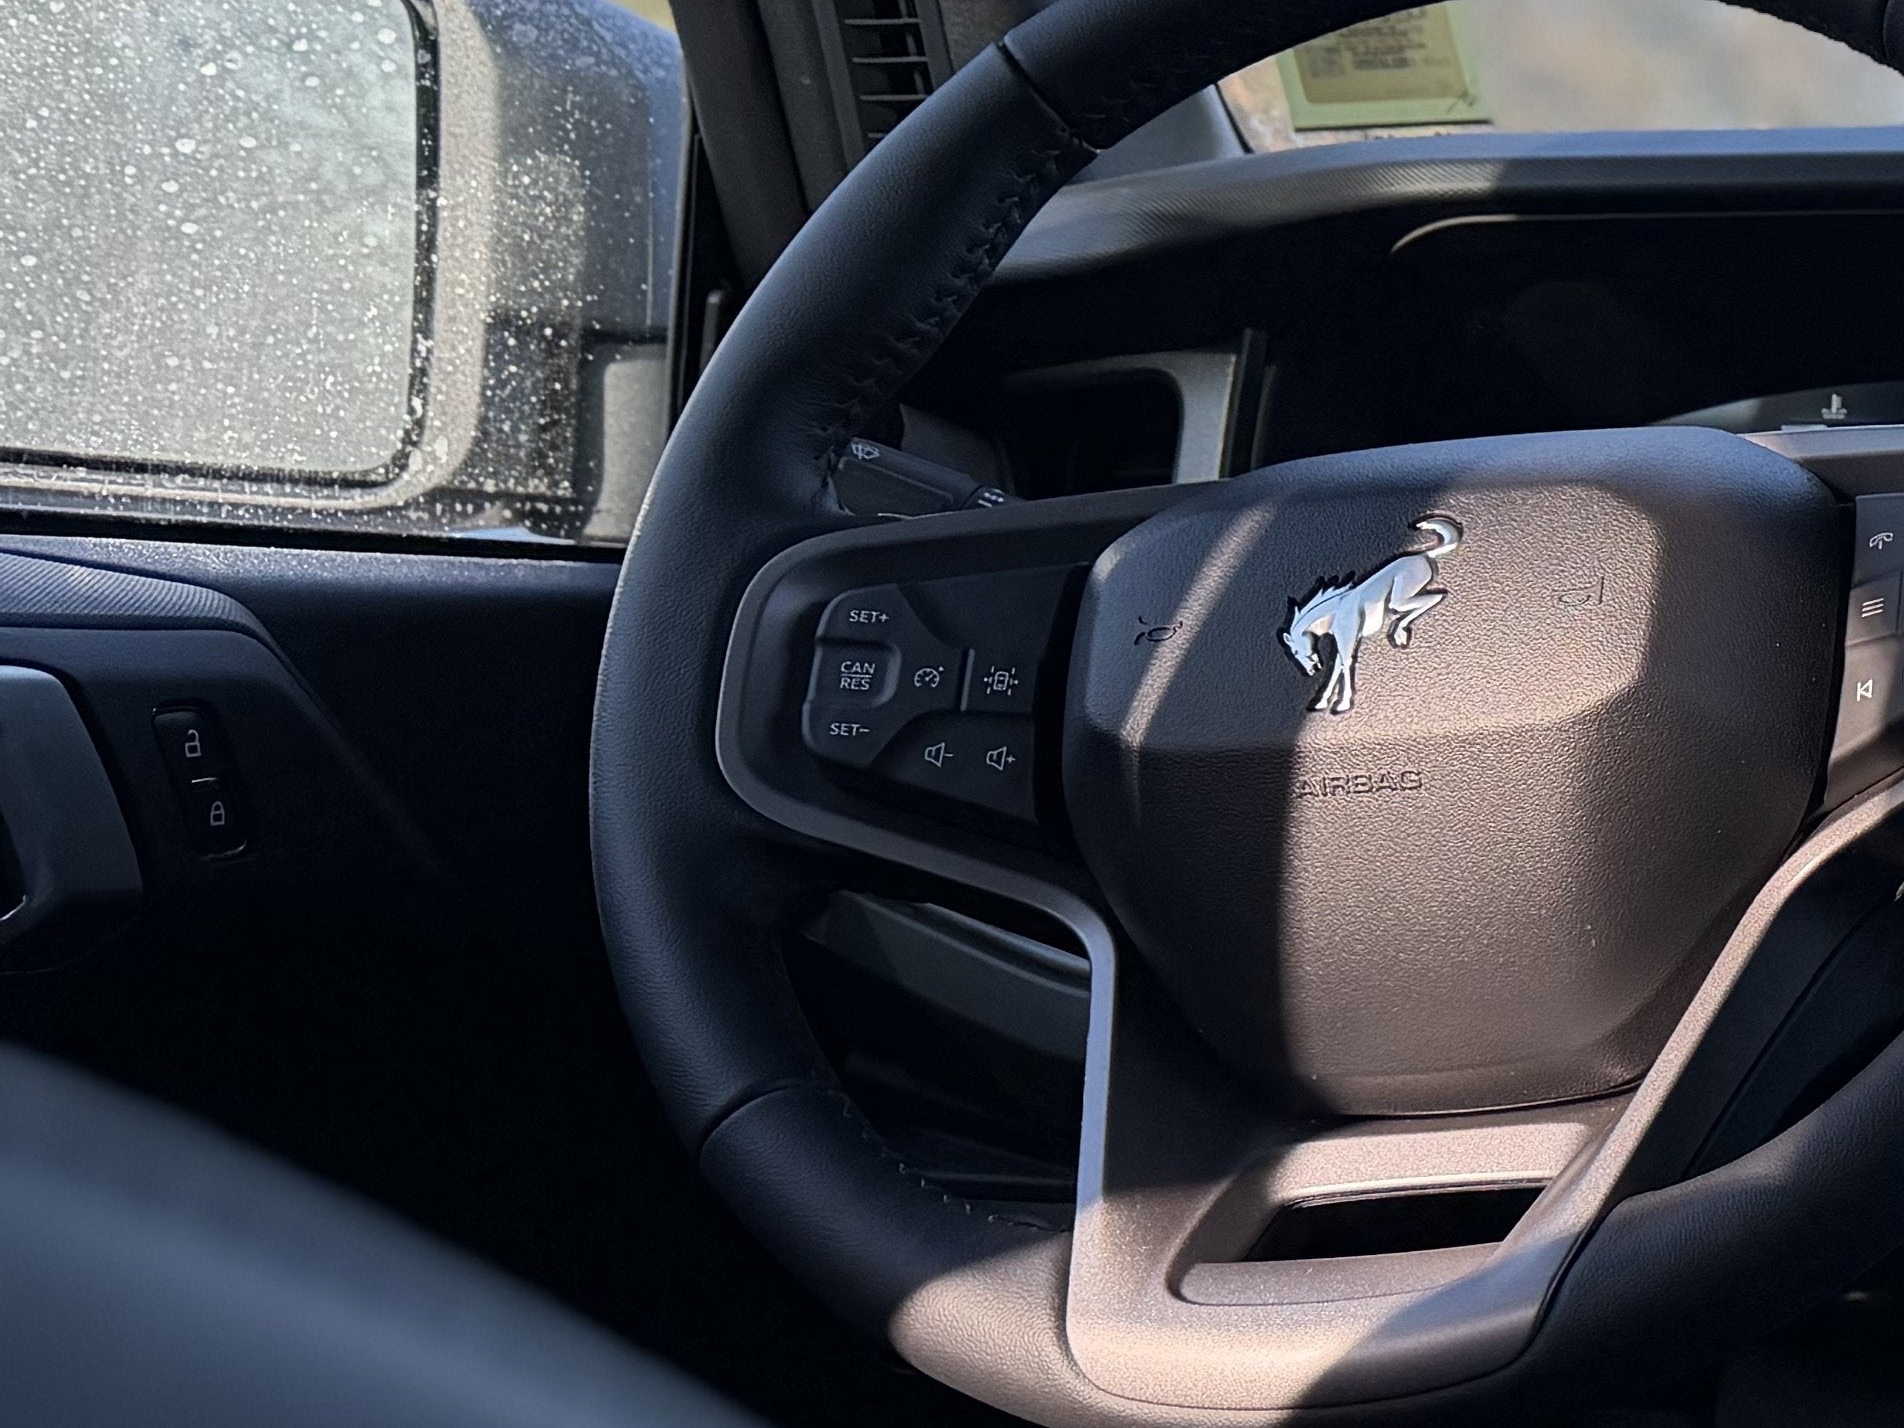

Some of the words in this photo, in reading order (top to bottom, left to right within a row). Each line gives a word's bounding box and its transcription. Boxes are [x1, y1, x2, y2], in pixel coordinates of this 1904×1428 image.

[848, 609, 890, 624] SET+
[840, 661, 876, 675] CAN
[839, 676, 873, 692] RES
[1297, 769, 1424, 799] AIRBAG
